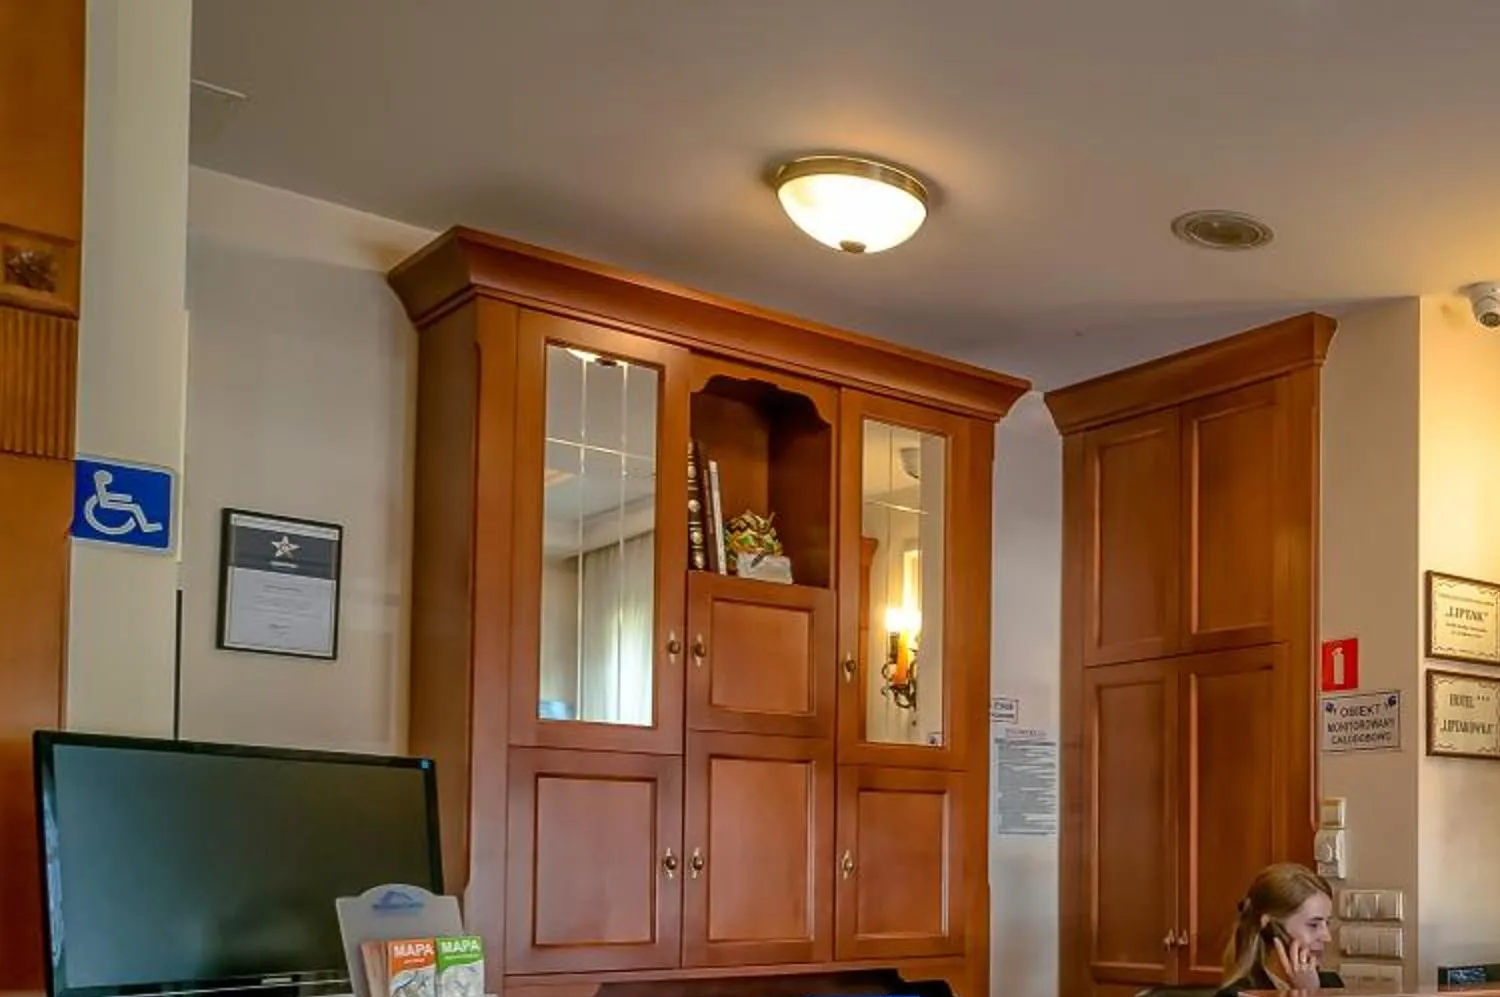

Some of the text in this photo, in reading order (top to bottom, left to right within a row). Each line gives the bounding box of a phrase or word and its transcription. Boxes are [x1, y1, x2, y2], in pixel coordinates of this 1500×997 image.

[1340, 703, 1381, 718] OBIEKT
[394, 943, 434, 957] MAPA
[441, 940, 479, 953] MAPA
